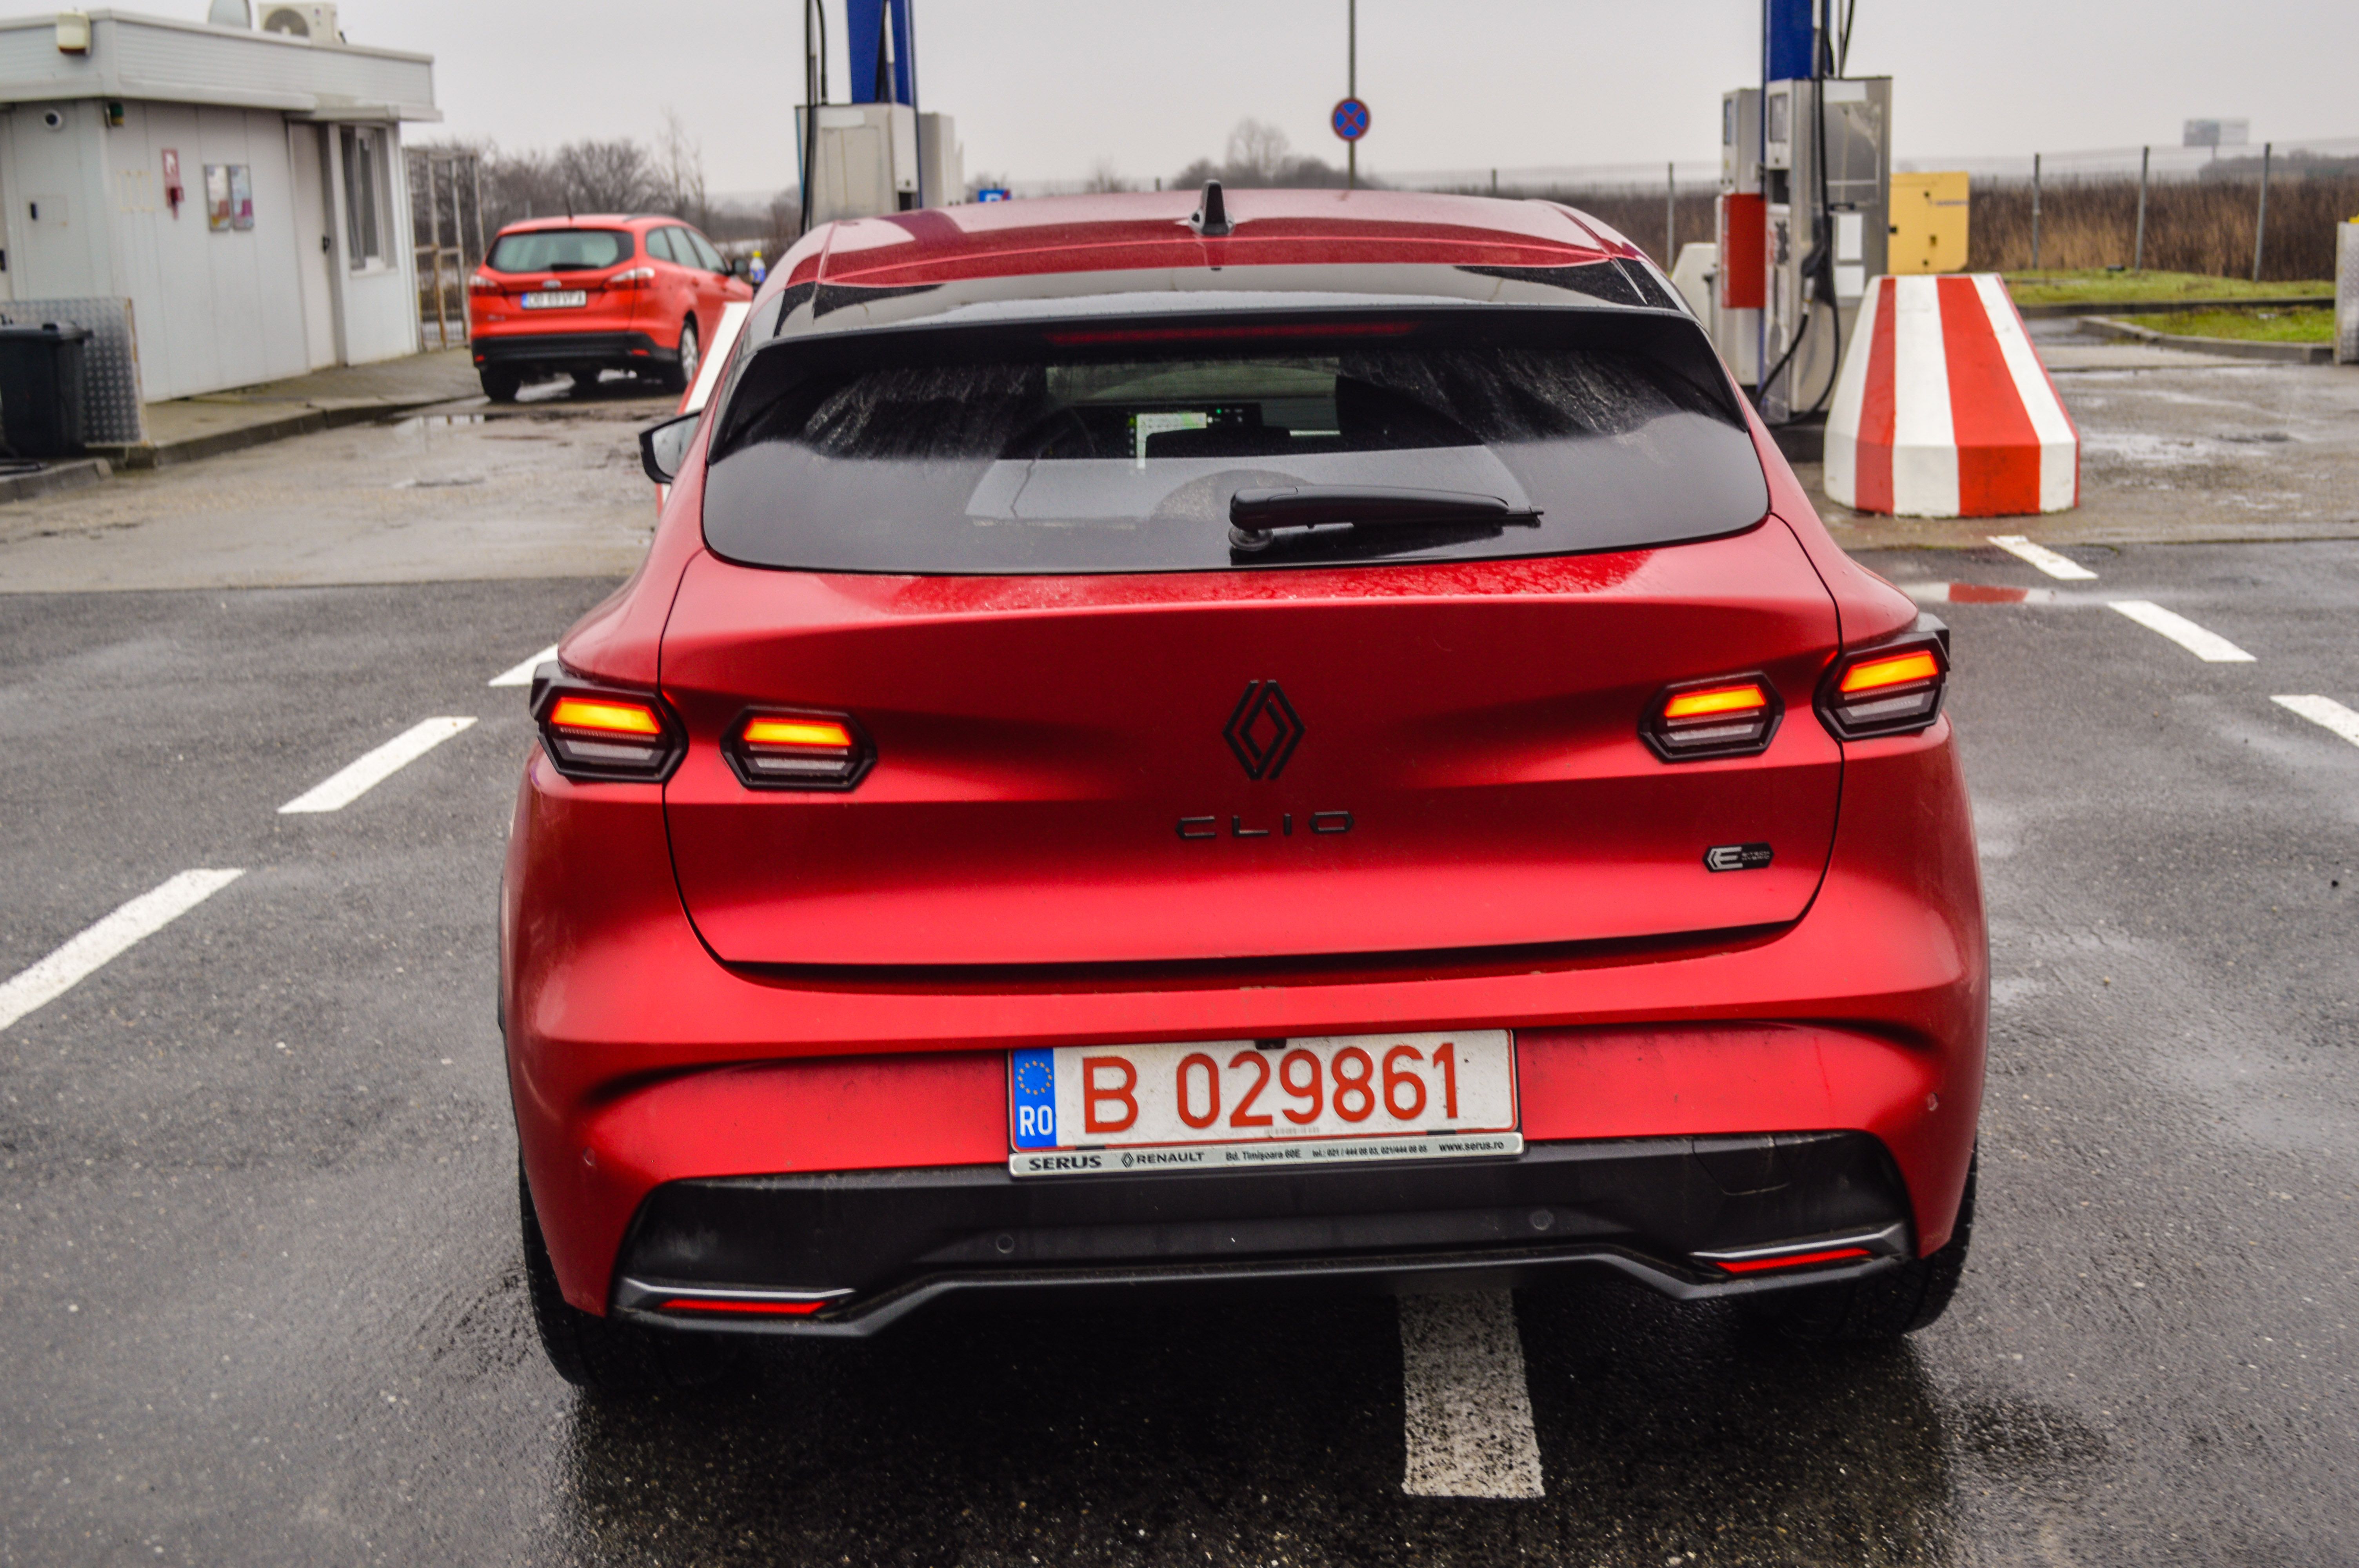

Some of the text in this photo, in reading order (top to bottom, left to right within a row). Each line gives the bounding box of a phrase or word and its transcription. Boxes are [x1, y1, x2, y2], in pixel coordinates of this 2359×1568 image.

[1175, 810, 1354, 839] CLIO
[1083, 1043, 1458, 1134] B 029861
[1019, 1105, 1054, 1136] RO
[1029, 1155, 1103, 1171] SERUS
[1137, 1152, 1205, 1163] RENAULT
[1439, 1141, 1505, 1152] www.serus.ro
